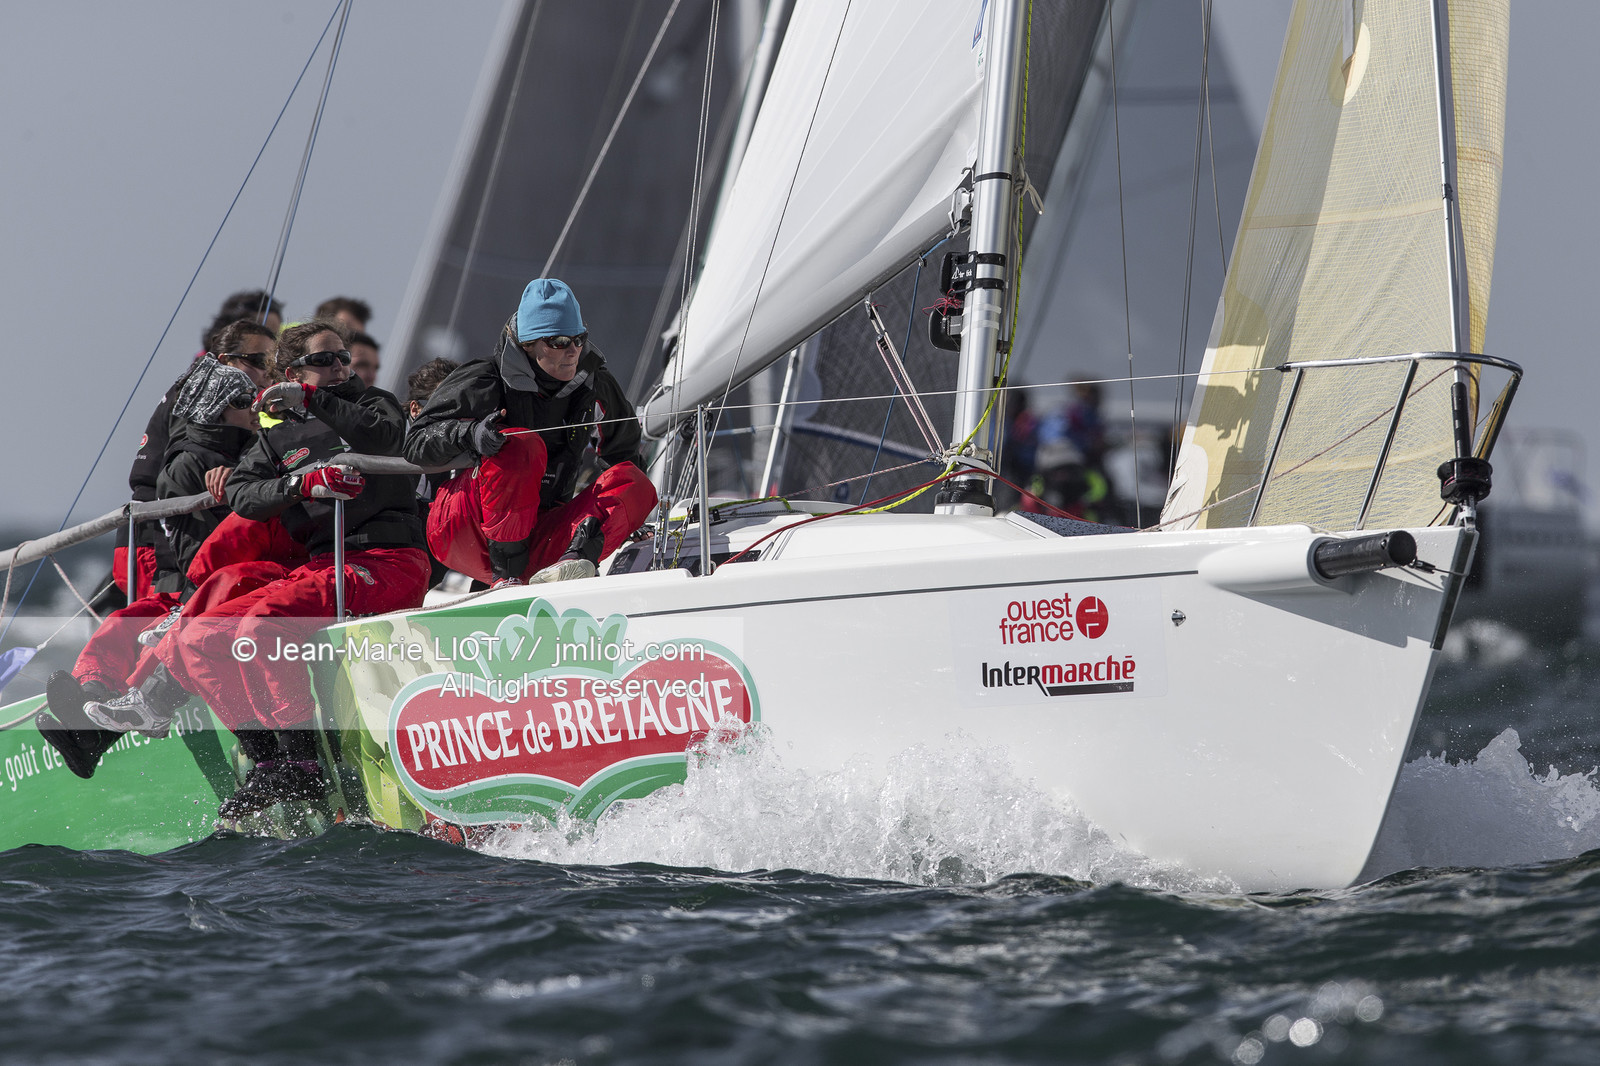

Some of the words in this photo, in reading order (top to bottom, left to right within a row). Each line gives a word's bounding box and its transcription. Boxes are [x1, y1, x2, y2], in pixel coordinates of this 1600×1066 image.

[1007, 593, 1073, 622] ouest
[999, 617, 1074, 645] france
[405, 710, 520, 772] PRINCE
[522, 709, 554, 756] de
[5, 742, 40, 792] goût
